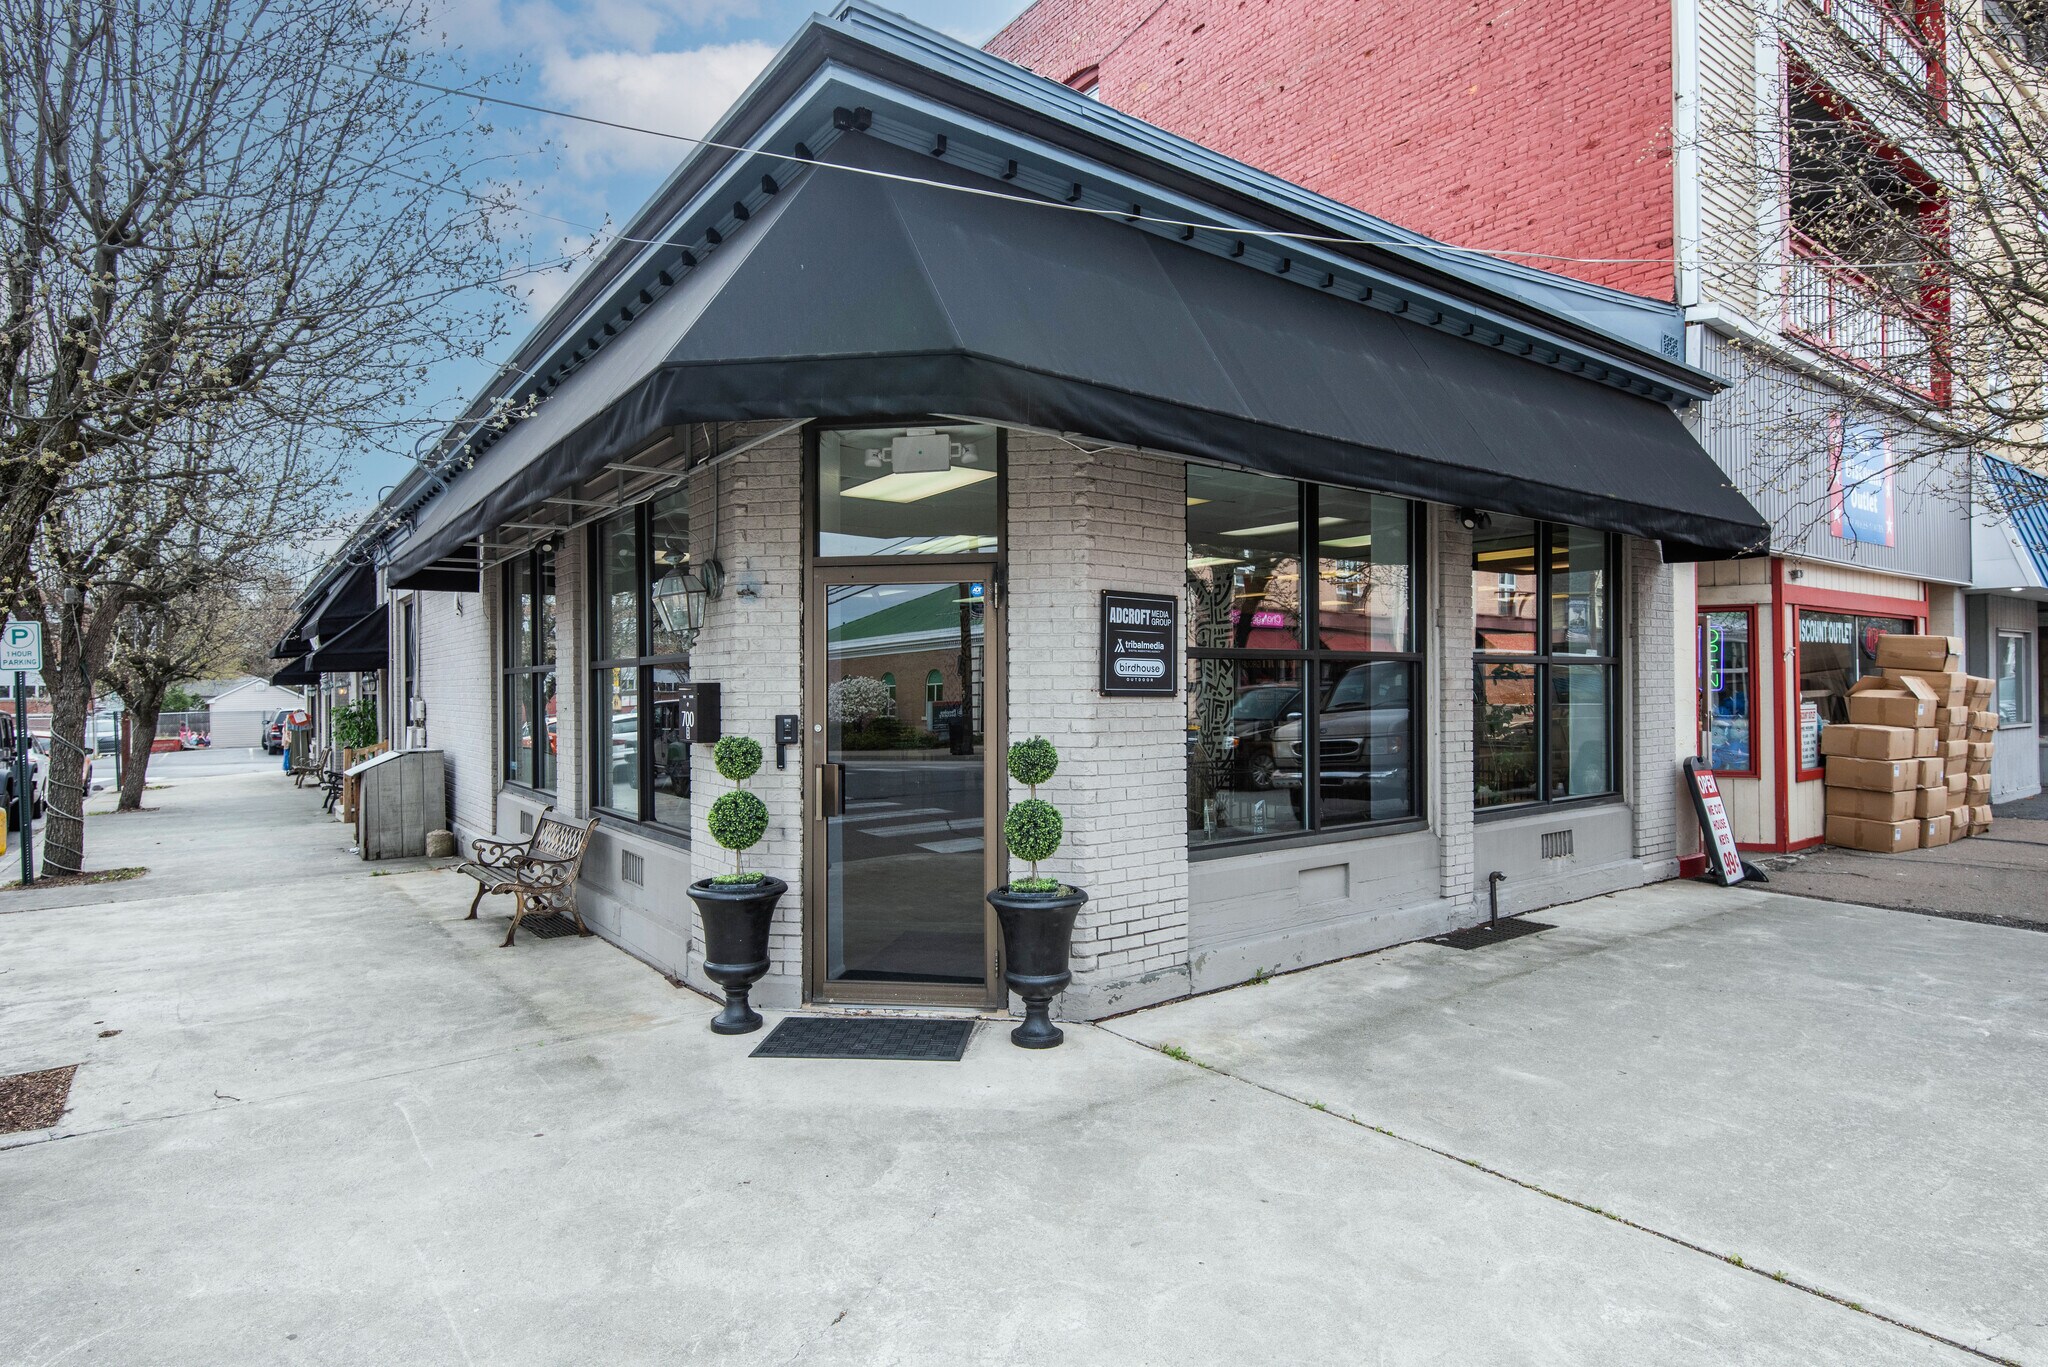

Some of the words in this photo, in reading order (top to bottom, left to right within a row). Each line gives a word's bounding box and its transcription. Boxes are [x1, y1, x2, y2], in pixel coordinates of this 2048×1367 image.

[1851, 489, 1878, 513] Outlet
[1109, 606, 1151, 625] ADCROFT
[1151, 610, 1169, 618] MEDIA
[1151, 618, 1172, 627] GROUP
[11, 628, 29, 645] P
[1828, 621, 1853, 644] OUTLET
[1125, 640, 1165, 650] tribalmedia
[1119, 662, 1161, 673] birdhouse
[681, 710, 695, 727] 700
[1697, 775, 1718, 794] OPEN
